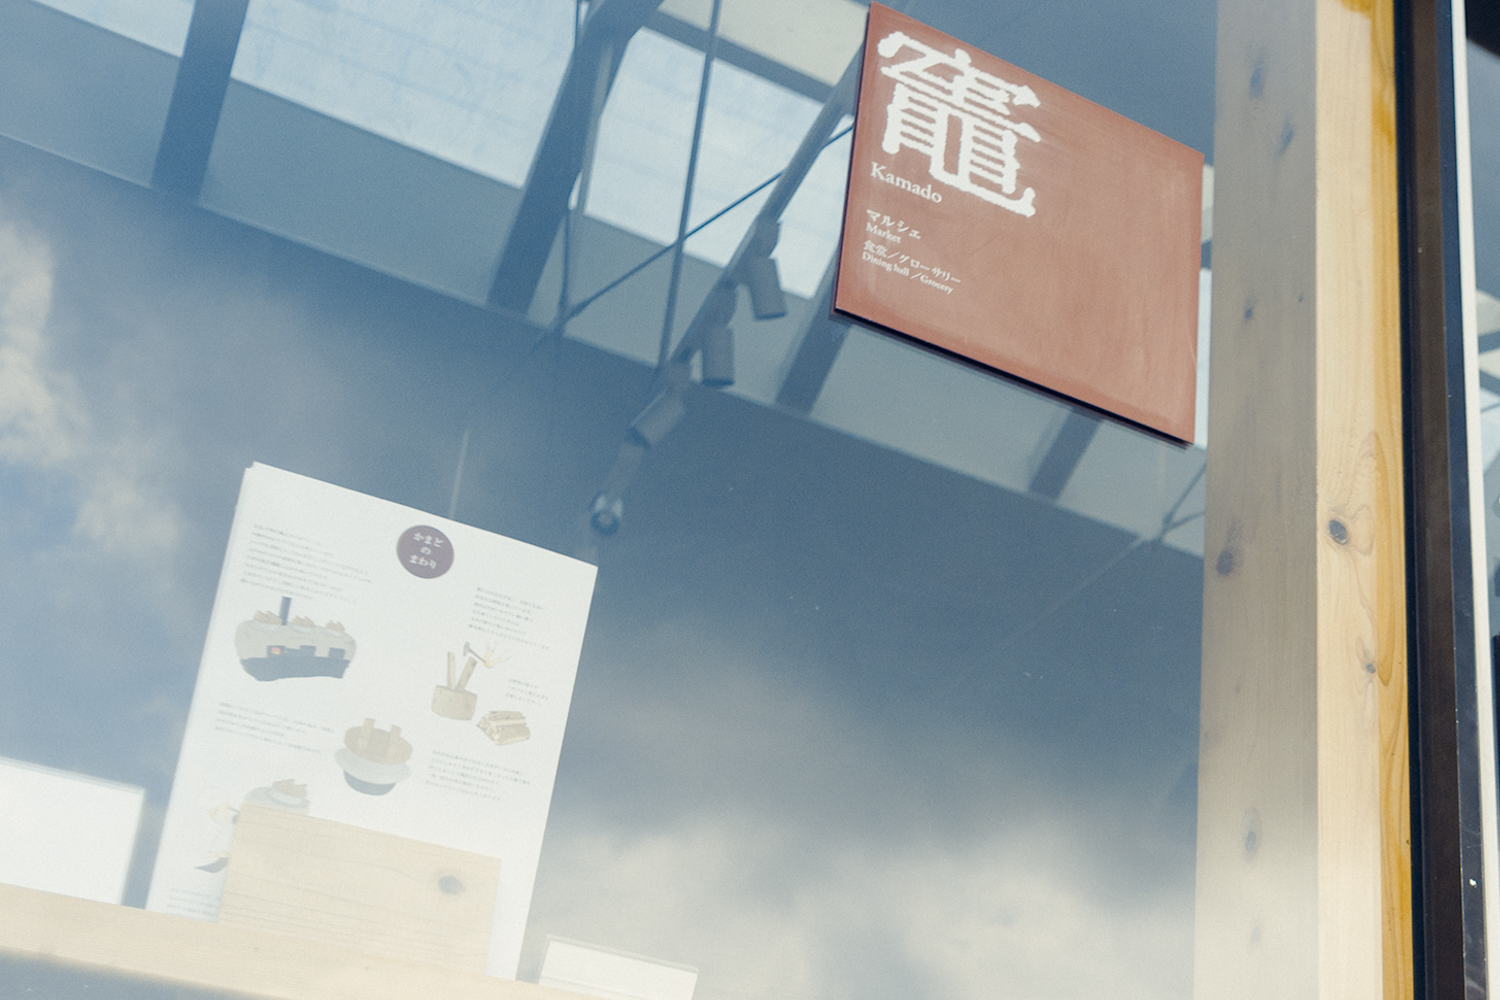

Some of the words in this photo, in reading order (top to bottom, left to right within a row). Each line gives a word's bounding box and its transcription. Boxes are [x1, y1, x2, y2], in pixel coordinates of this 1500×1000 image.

[870, 161, 943, 204] Kamado
[865, 221, 902, 244] Market
[866, 208, 922, 240] マルシェ
[862, 251, 892, 272] Dining
[413, 532, 444, 548] かまど
[420, 546, 431, 555] の
